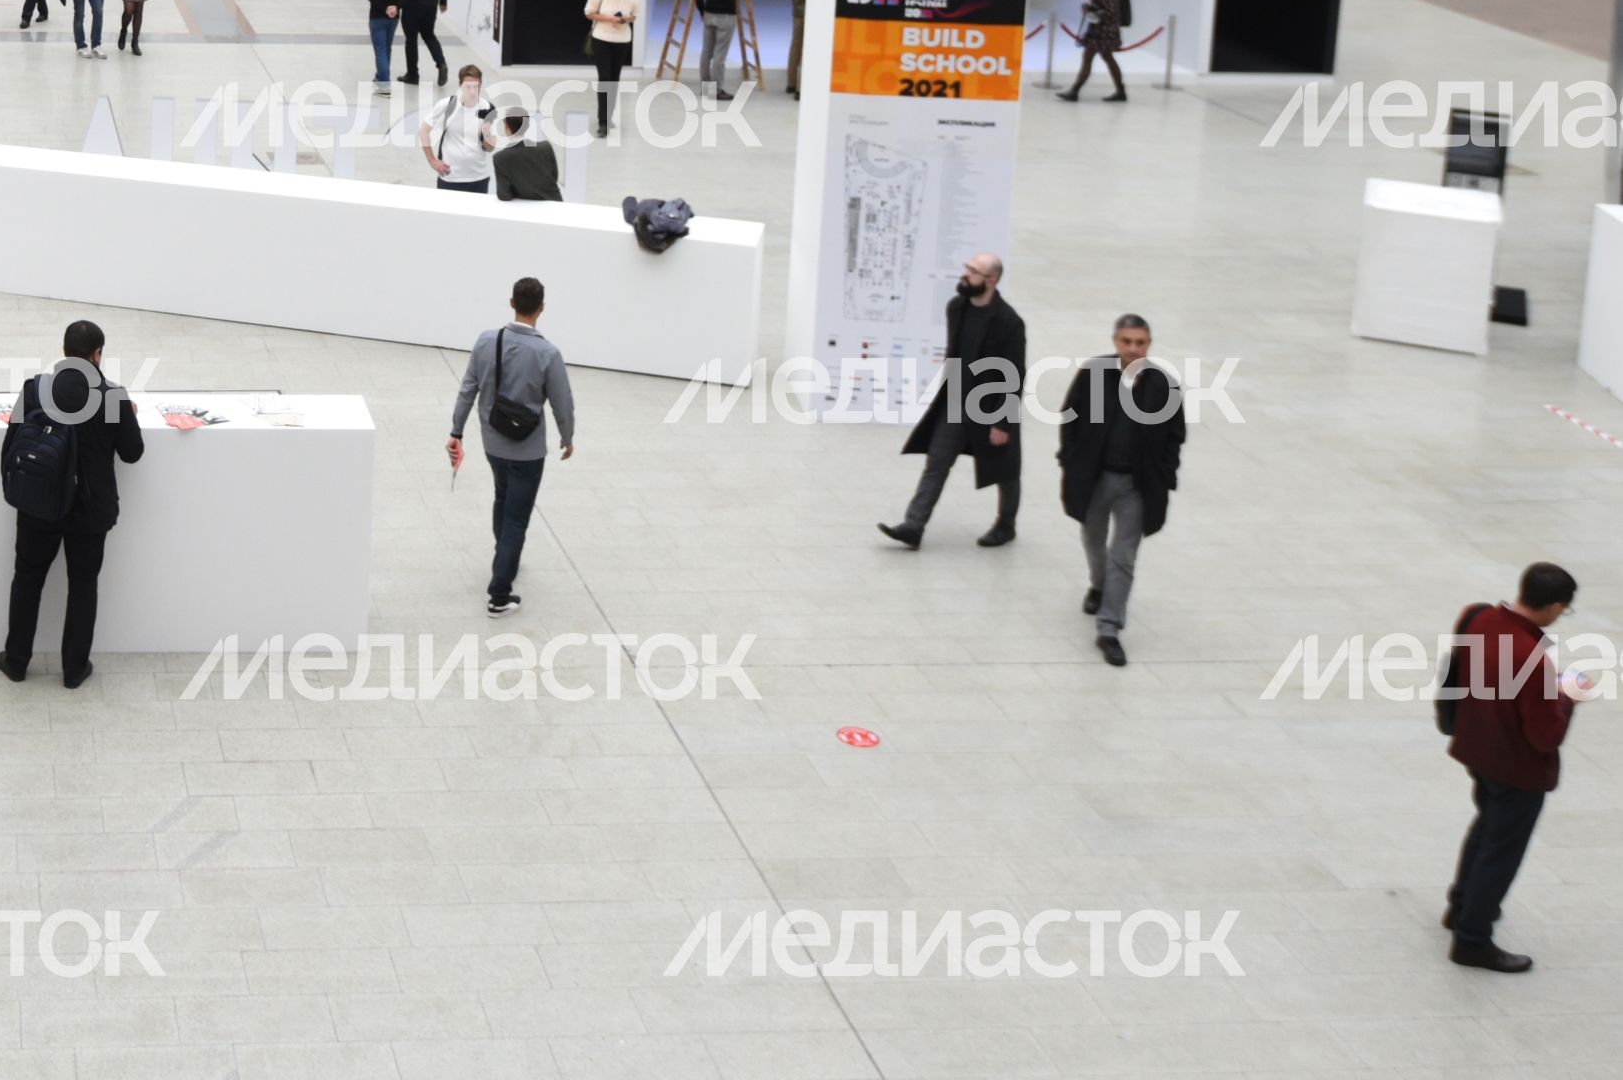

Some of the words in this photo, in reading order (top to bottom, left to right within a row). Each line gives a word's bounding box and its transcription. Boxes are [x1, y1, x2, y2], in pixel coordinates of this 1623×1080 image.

[902, 27, 985, 49] BUILD
[900, 52, 1012, 76] SCHOOL
[899, 78, 962, 98] 2021
